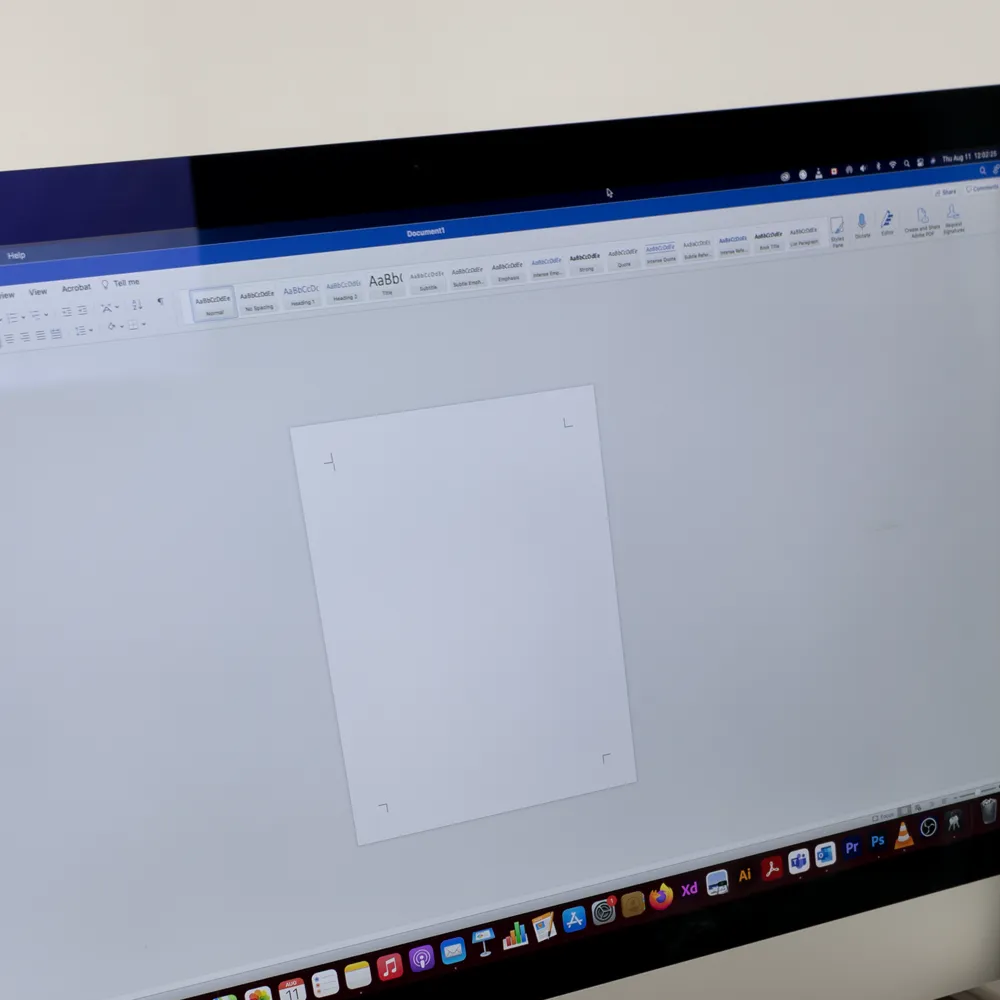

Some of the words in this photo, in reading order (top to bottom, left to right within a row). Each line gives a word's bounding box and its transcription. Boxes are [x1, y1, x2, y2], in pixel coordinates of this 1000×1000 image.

[407, 227, 445, 238] Document1
[7, 252, 26, 260] Help
[29, 288, 48, 296] View
[62, 283, 92, 293] Acrobat
[254, 304, 274, 312] Spacing
[872, 836, 885, 847] Ps
[846, 842, 859, 854] Pr
[738, 869, 752, 882] Ai
[681, 882, 698, 897] Xd
